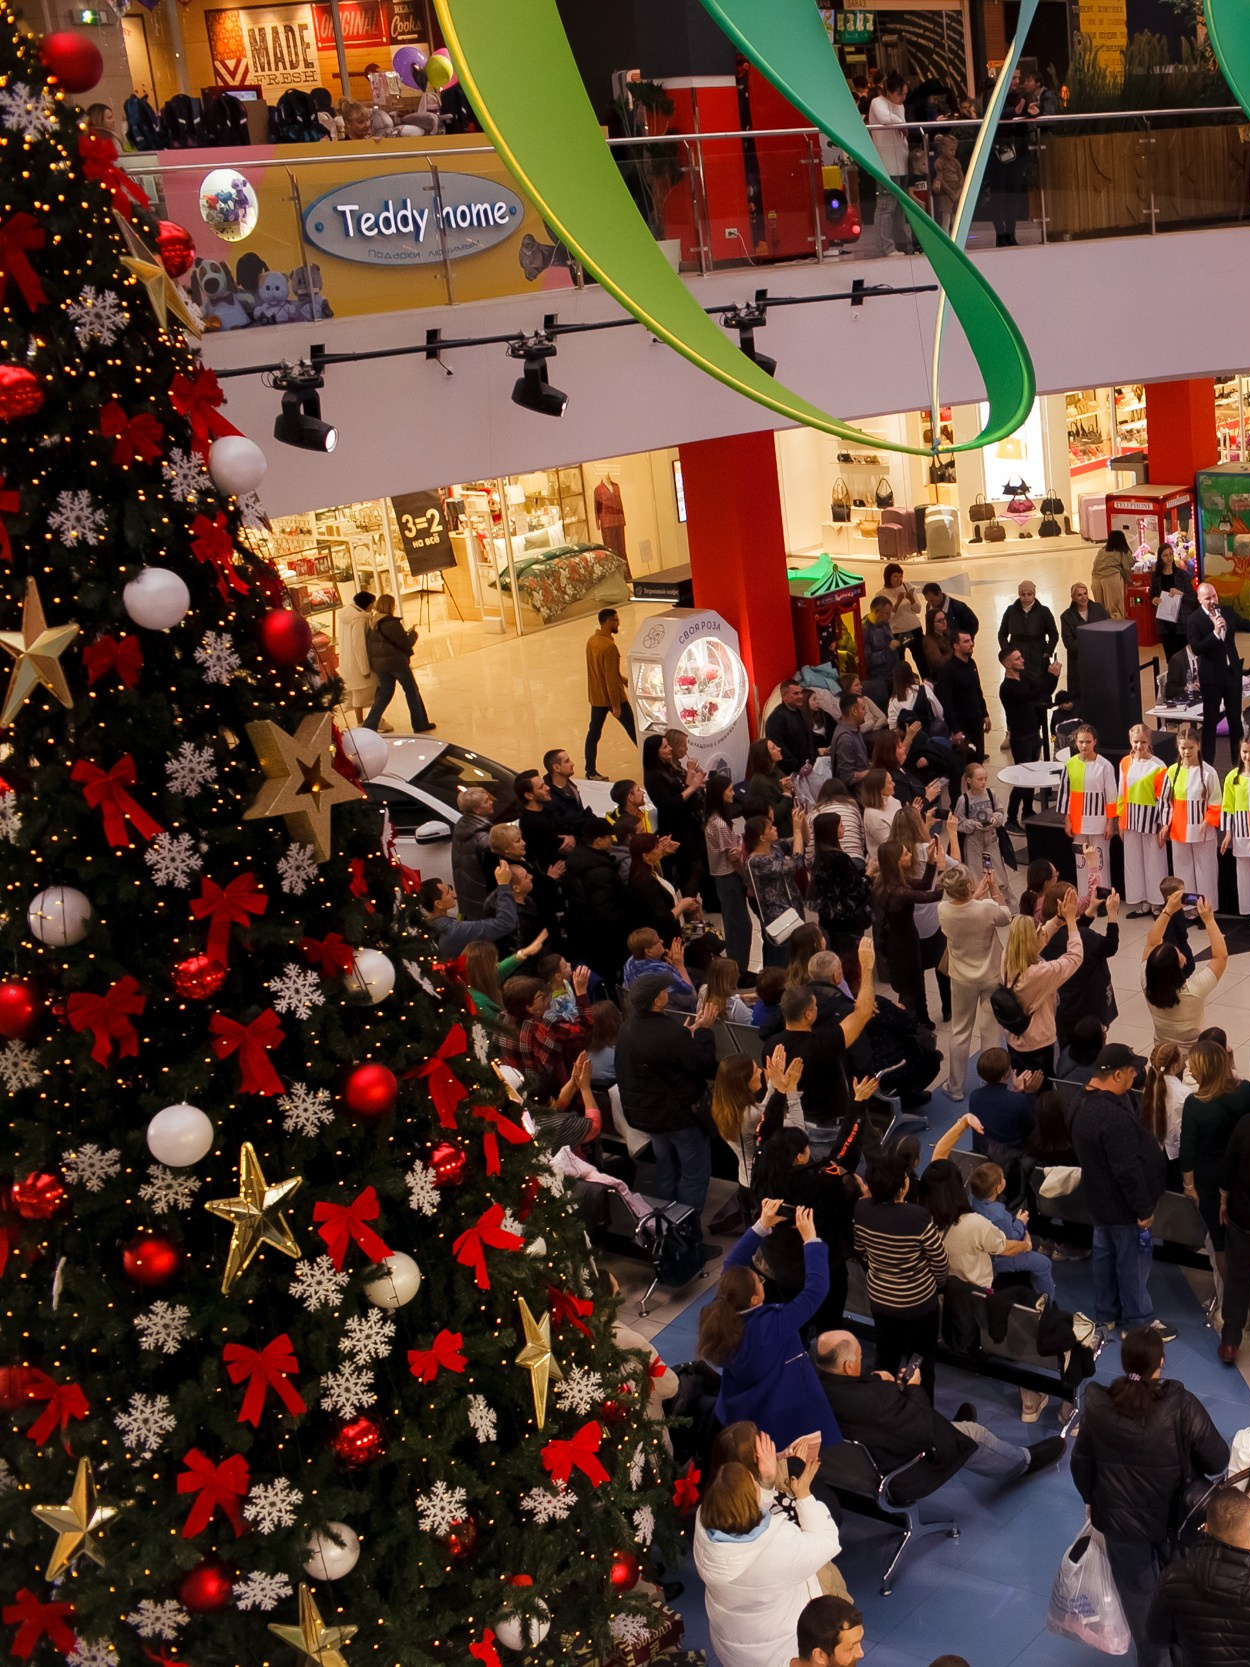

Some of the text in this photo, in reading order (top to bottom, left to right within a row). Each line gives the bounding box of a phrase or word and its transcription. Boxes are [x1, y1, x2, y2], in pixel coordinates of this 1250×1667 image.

[391, 15, 423, 38] Cooks
[248, 23, 315, 73] MADE
[253, 70, 318, 85] FRESH
[336, 196, 511, 243] Teddy home
[367, 240, 480, 260] Подарки люимым
[1116, 502, 1152, 510] TELEPHONE
[401, 508, 443, 538] 3=2
[412, 533, 440, 549] на всё
[679, 620, 721, 645] СВОЯ РОЗА
